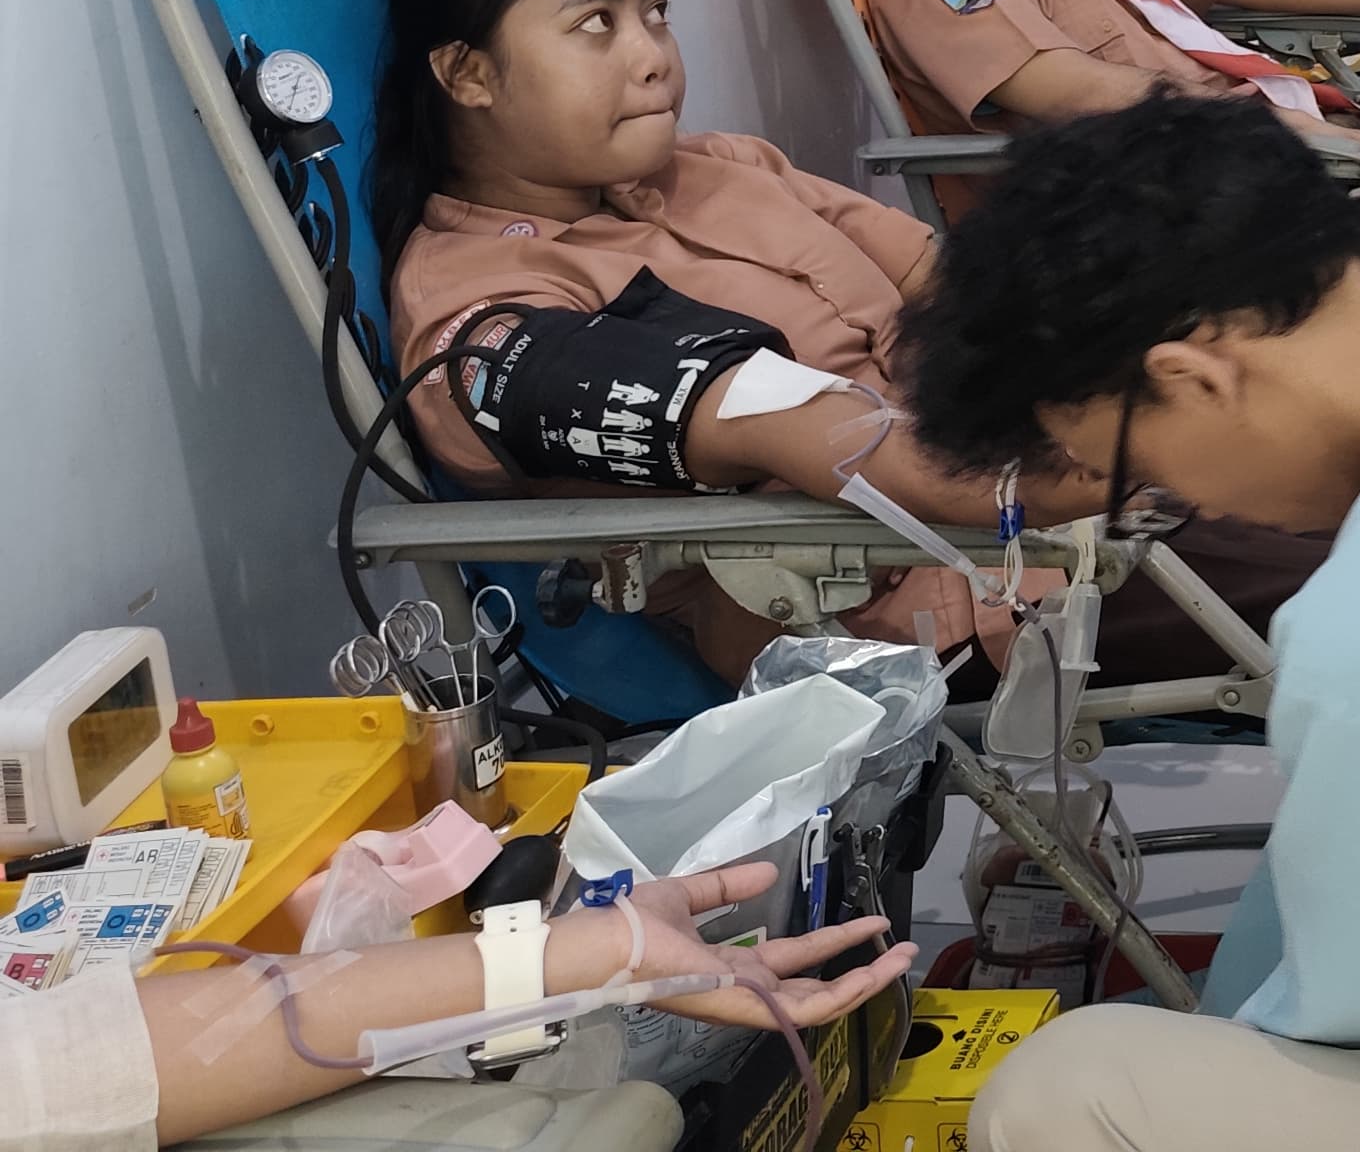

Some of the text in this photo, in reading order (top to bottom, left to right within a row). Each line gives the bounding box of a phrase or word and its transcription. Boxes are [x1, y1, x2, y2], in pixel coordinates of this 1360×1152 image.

[492, 334, 532, 403] ADULT SIZE
[673, 387, 689, 406] MAX
[667, 441, 690, 481] RANGE
[135, 848, 159, 864] AB
[949, 1008, 994, 1070] BUANG DISINI
